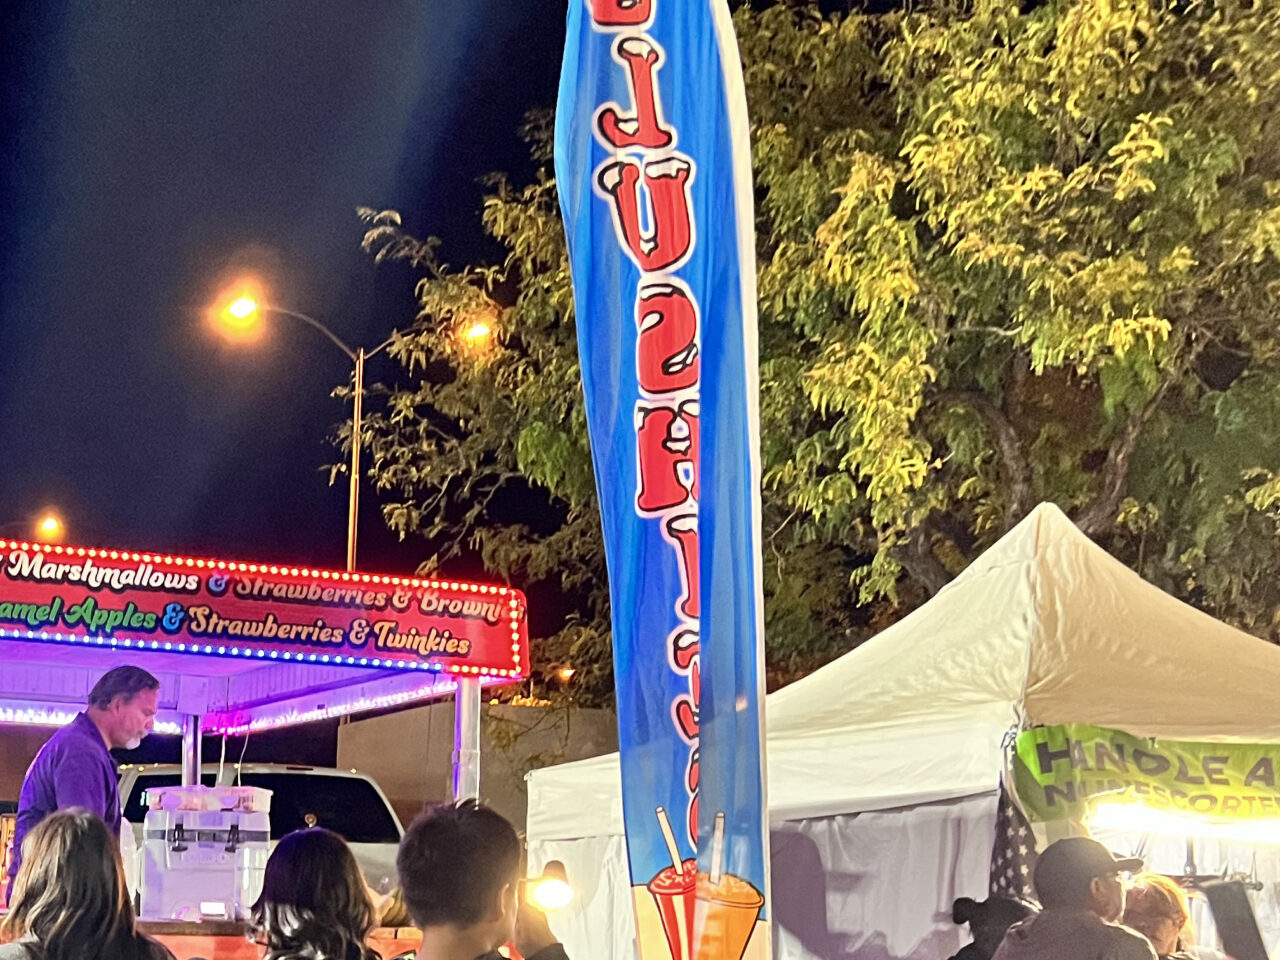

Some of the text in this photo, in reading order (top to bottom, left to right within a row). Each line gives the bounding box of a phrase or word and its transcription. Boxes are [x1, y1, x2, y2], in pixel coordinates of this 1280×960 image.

[8, 550, 199, 590] Marshmallows
[235, 576, 387, 607] Strawberries
[392, 586, 413, 609] &
[64, 597, 157, 633] Apples
[162, 604, 184, 631] &
[188, 606, 345, 644] Strawberries
[349, 619, 370, 646] &
[374, 621, 470, 655] Twinkies
